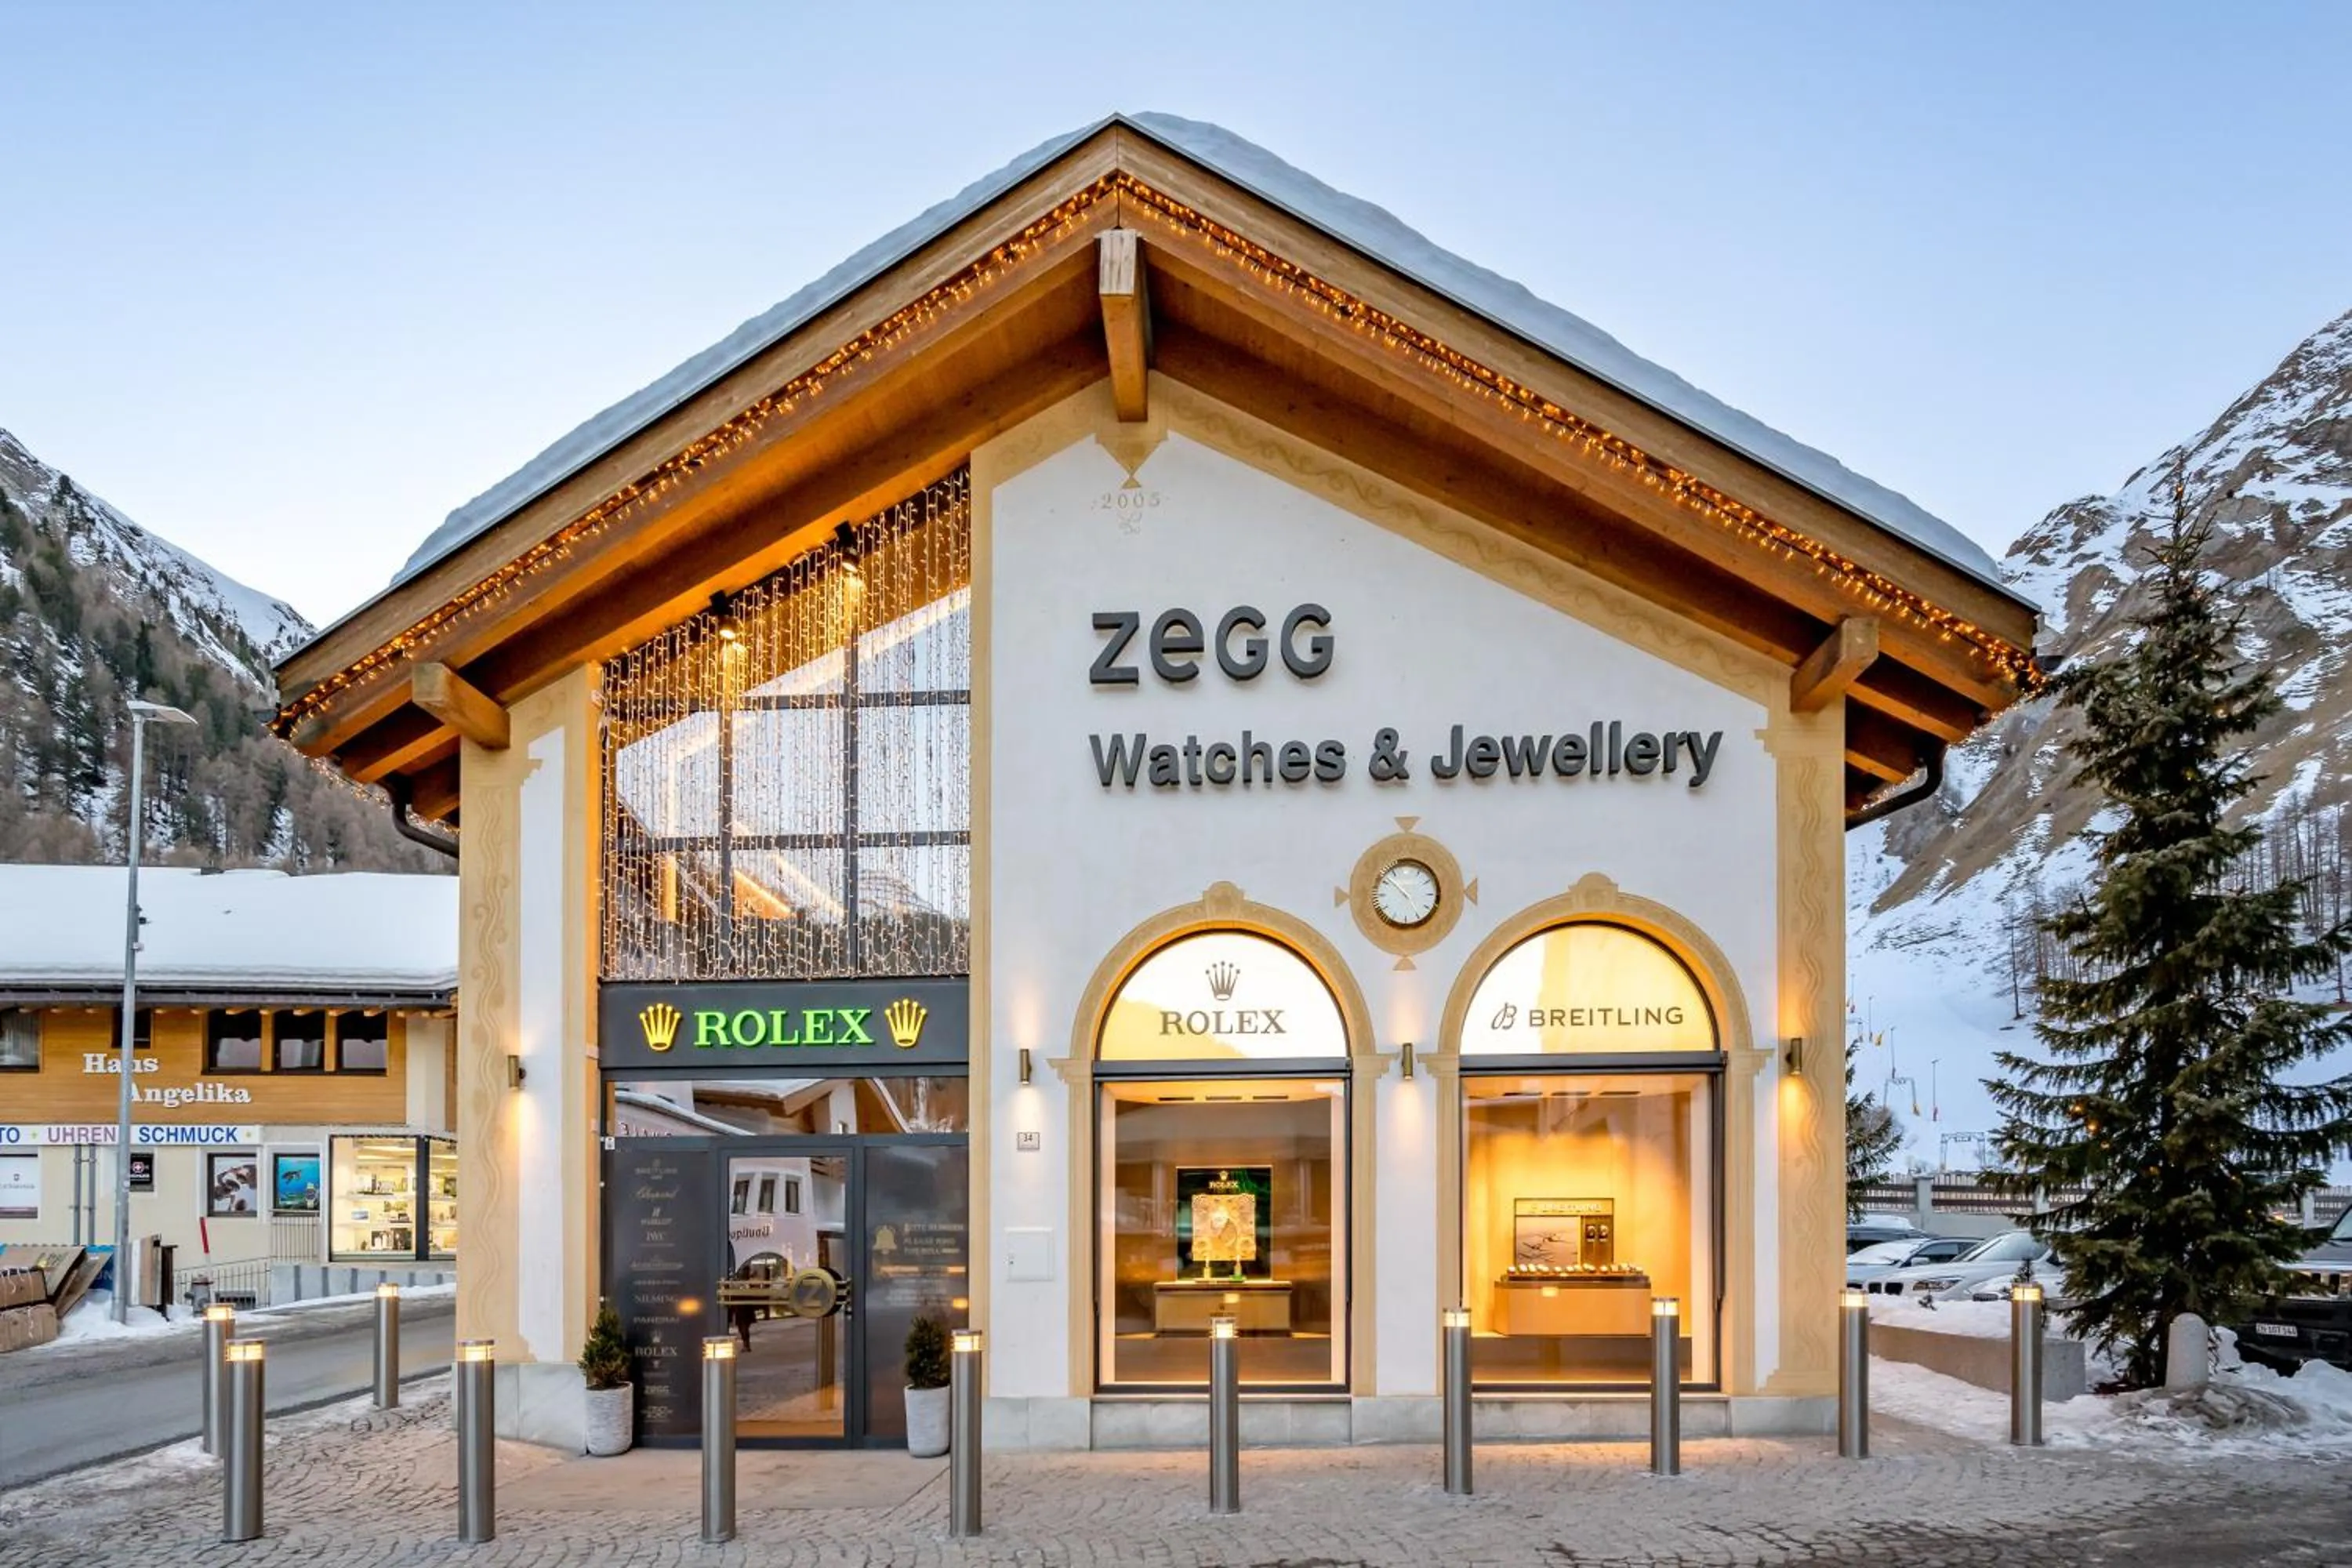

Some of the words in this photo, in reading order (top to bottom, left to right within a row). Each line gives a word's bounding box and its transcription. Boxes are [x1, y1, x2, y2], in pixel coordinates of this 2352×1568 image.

[1088, 730, 1347, 787] Watches
[1368, 727, 1410, 781] &
[1430, 720, 1723, 787] Jewellery
[694, 1009, 875, 1047] ROLEX
[1159, 1010, 1287, 1035] ROLEX
[1530, 1007, 1684, 1028] BREITLING
[131, 1082, 252, 1108] Angelika
[48, 1127, 116, 1142] UHREN
[139, 1127, 238, 1143] SCHMUCK
[634, 1347, 678, 1356] ROLEX
